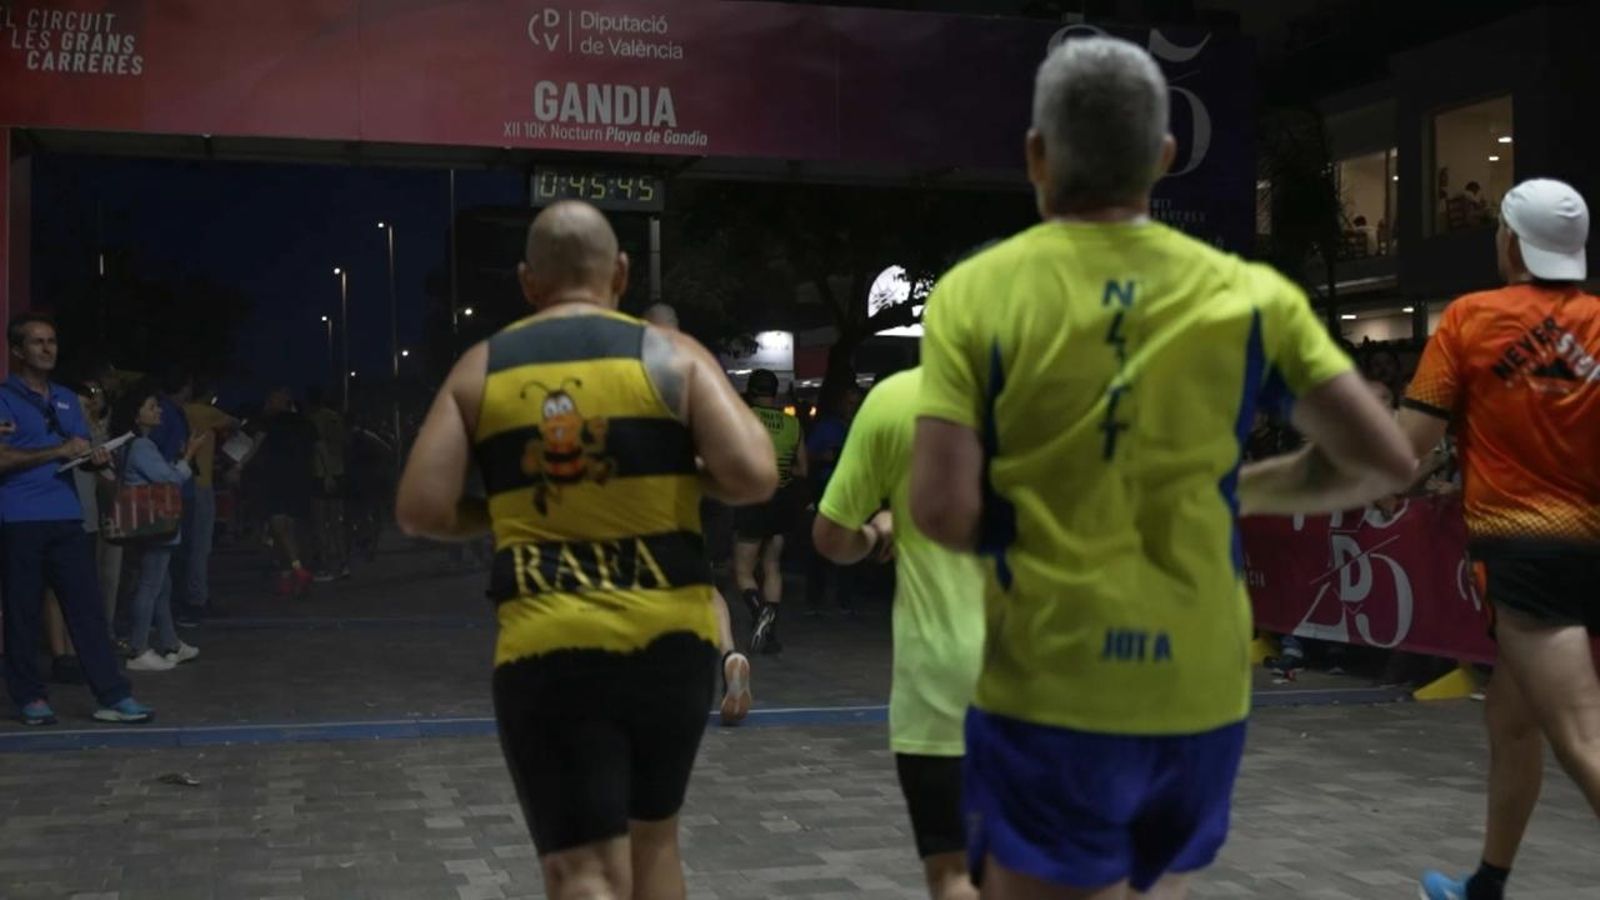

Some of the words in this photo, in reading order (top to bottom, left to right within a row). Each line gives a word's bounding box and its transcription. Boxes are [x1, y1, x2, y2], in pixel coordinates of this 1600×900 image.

[27, 8, 117, 33] CIRCUIT
[580, 10, 668, 34] Diputació
[12, 29, 51, 50] LES
[61, 31, 136, 54] GRANS
[580, 37, 604, 54] de
[609, 38, 684, 60] València
[27, 50, 144, 76] CARRERES
[534, 80, 678, 128] GANDIA
[503, 122, 521, 138] XII
[524, 123, 547, 138] 10K
[551, 124, 602, 141] Nocturn
[605, 127, 641, 144] Playa
[644, 129, 660, 144] de
[663, 130, 708, 147] Gandia
[540, 171, 654, 201] 0:45:45
[512, 536, 673, 595] RAFA
[1103, 628, 1172, 662] JOTA
